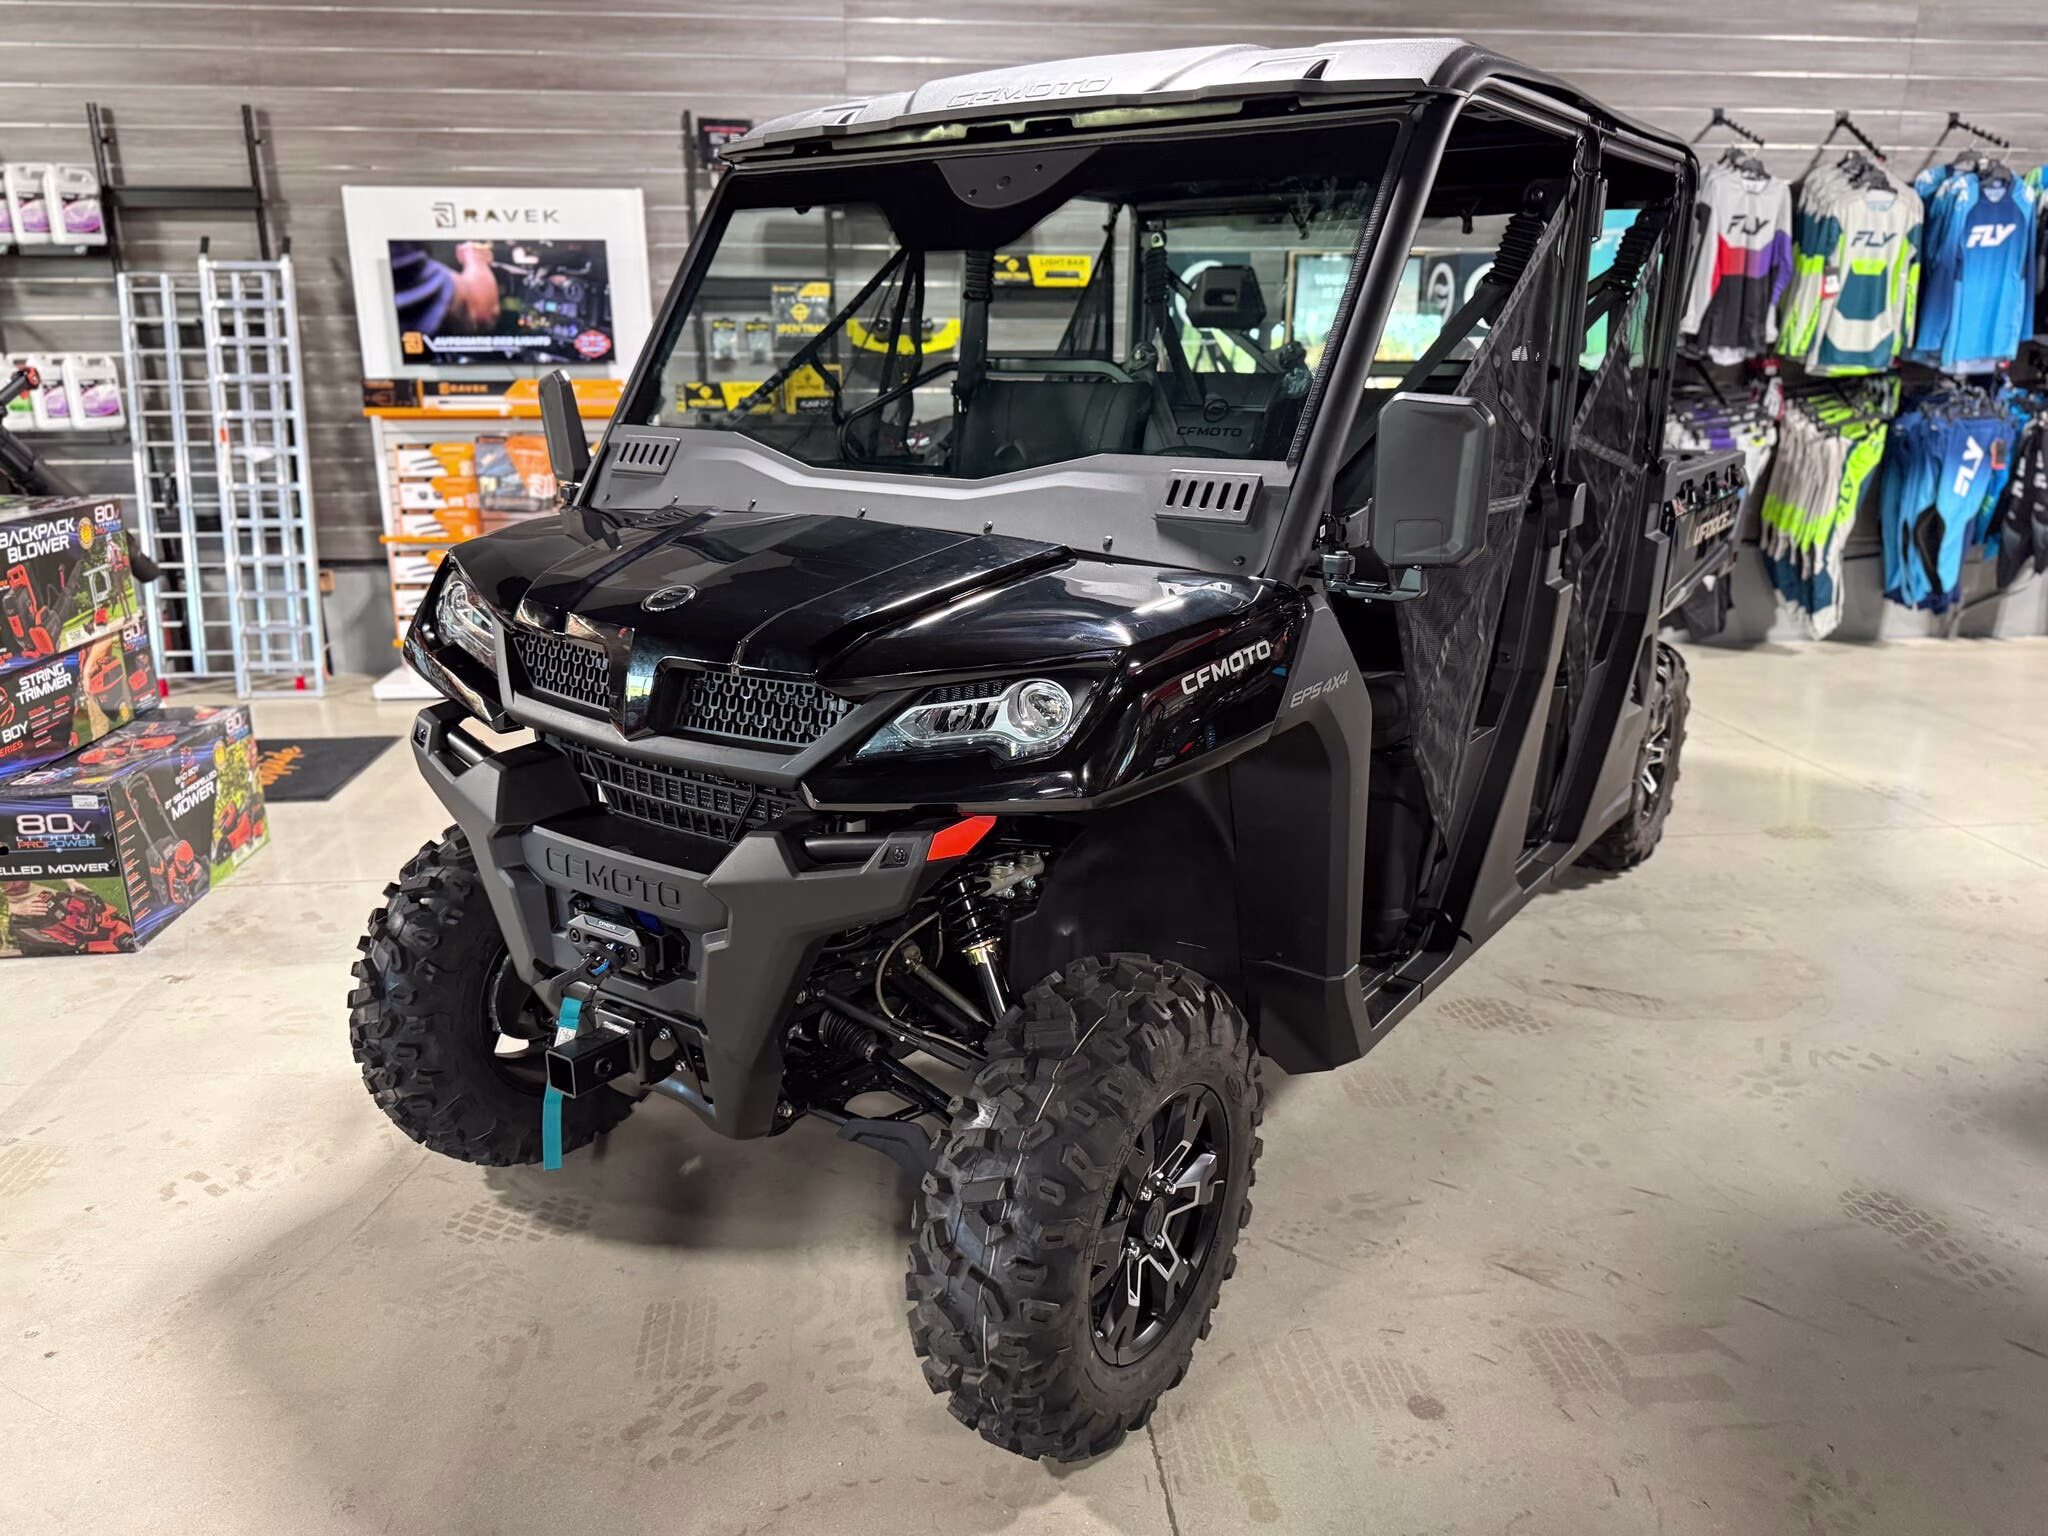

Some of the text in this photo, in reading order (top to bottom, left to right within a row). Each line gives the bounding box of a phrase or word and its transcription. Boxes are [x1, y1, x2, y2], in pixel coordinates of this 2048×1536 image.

[945, 77, 1113, 107] CFMOTO
[463, 208, 560, 225] RAVEK
[1726, 214, 1770, 235] FLY
[1851, 230, 1897, 249] FLY
[1966, 223, 2016, 248] FLY
[1176, 426, 1242, 437] CFMOTO
[1953, 435, 1985, 498] FLY
[0, 517, 76, 549] BACKPACK
[7, 535, 70, 564] BLOWER
[19, 662, 65, 691] STRING
[1180, 639, 1271, 696] CFMOTO
[15, 672, 73, 705] TRIMMER
[1289, 682, 1322, 709] EPS
[2, 720, 29, 744] BOY
[170, 780, 216, 822] MOWER
[16, 833, 96, 842] LITHIUM
[17, 839, 97, 849] PROPOWER
[48, 862, 110, 874] MOWER
[546, 847, 681, 911] CFMOTO
